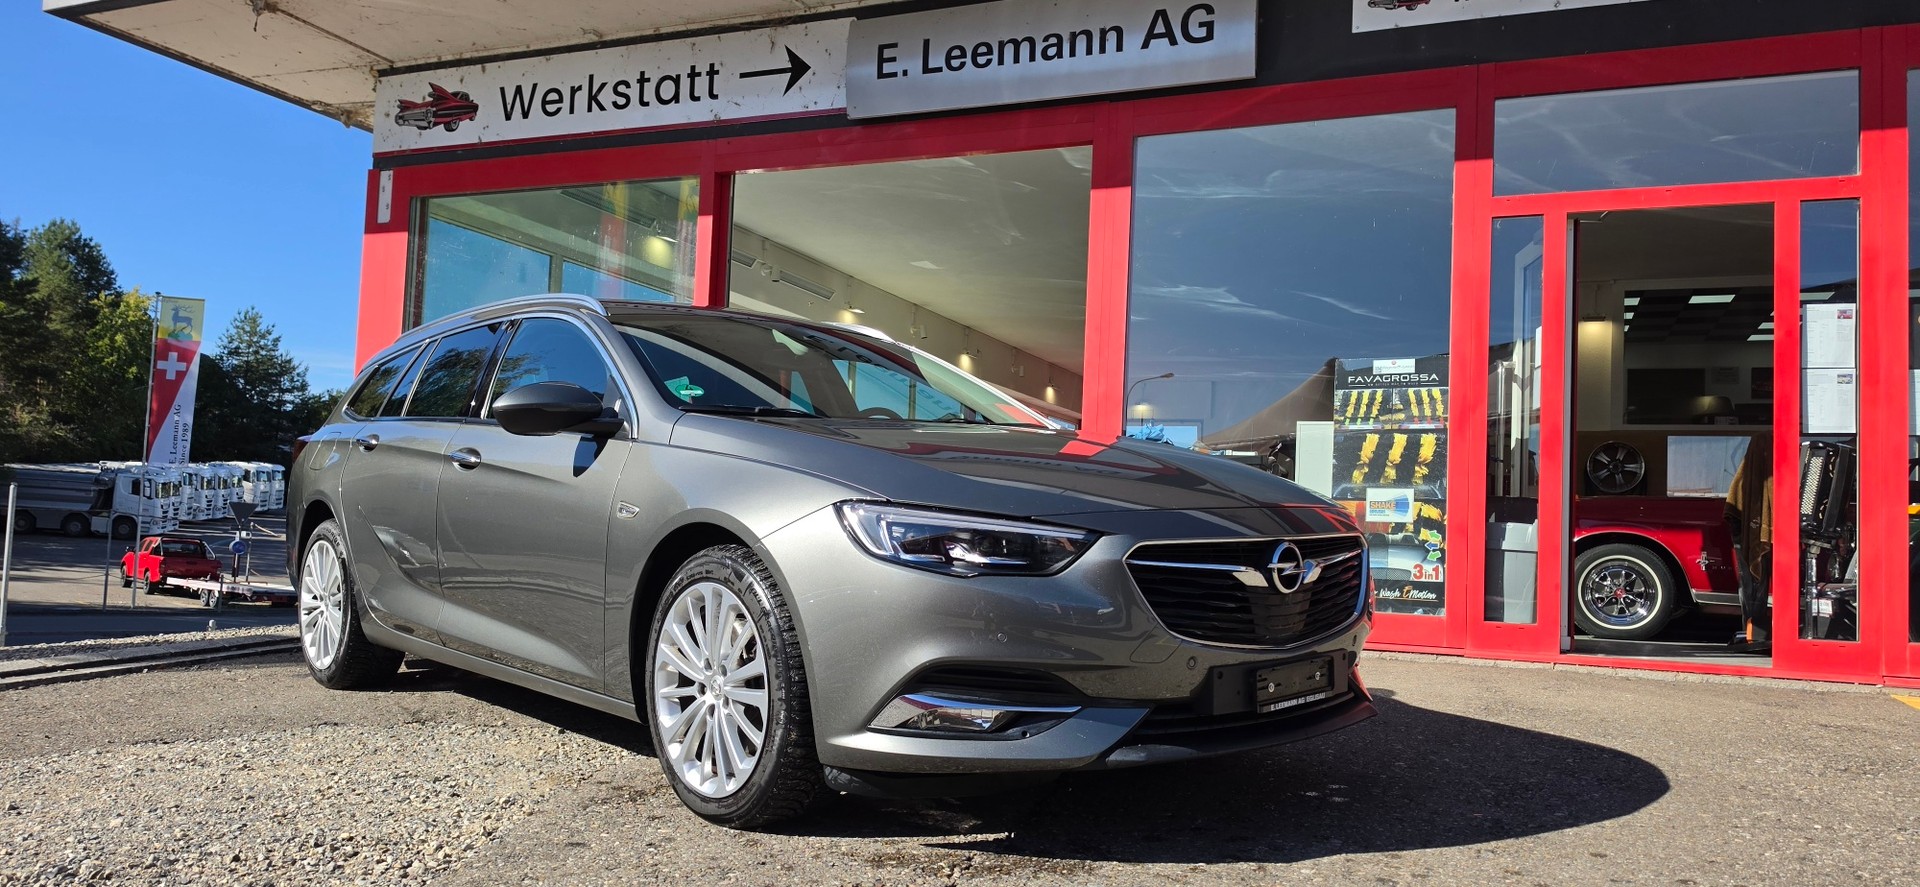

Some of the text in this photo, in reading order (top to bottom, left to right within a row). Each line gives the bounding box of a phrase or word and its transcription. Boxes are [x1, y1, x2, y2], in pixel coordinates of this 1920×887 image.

[876, 3, 1216, 80] E. Leemann AG
[499, 62, 720, 122] Werkstatt
[1347, 373, 1439, 384] FAVAGROSSA
[173, 404, 182, 418] AG
[169, 419, 180, 455] Leemann
[179, 422, 190, 465] Since 1989
[1370, 501, 1396, 509] SHAKE
[1379, 587, 1401, 599] Wash
